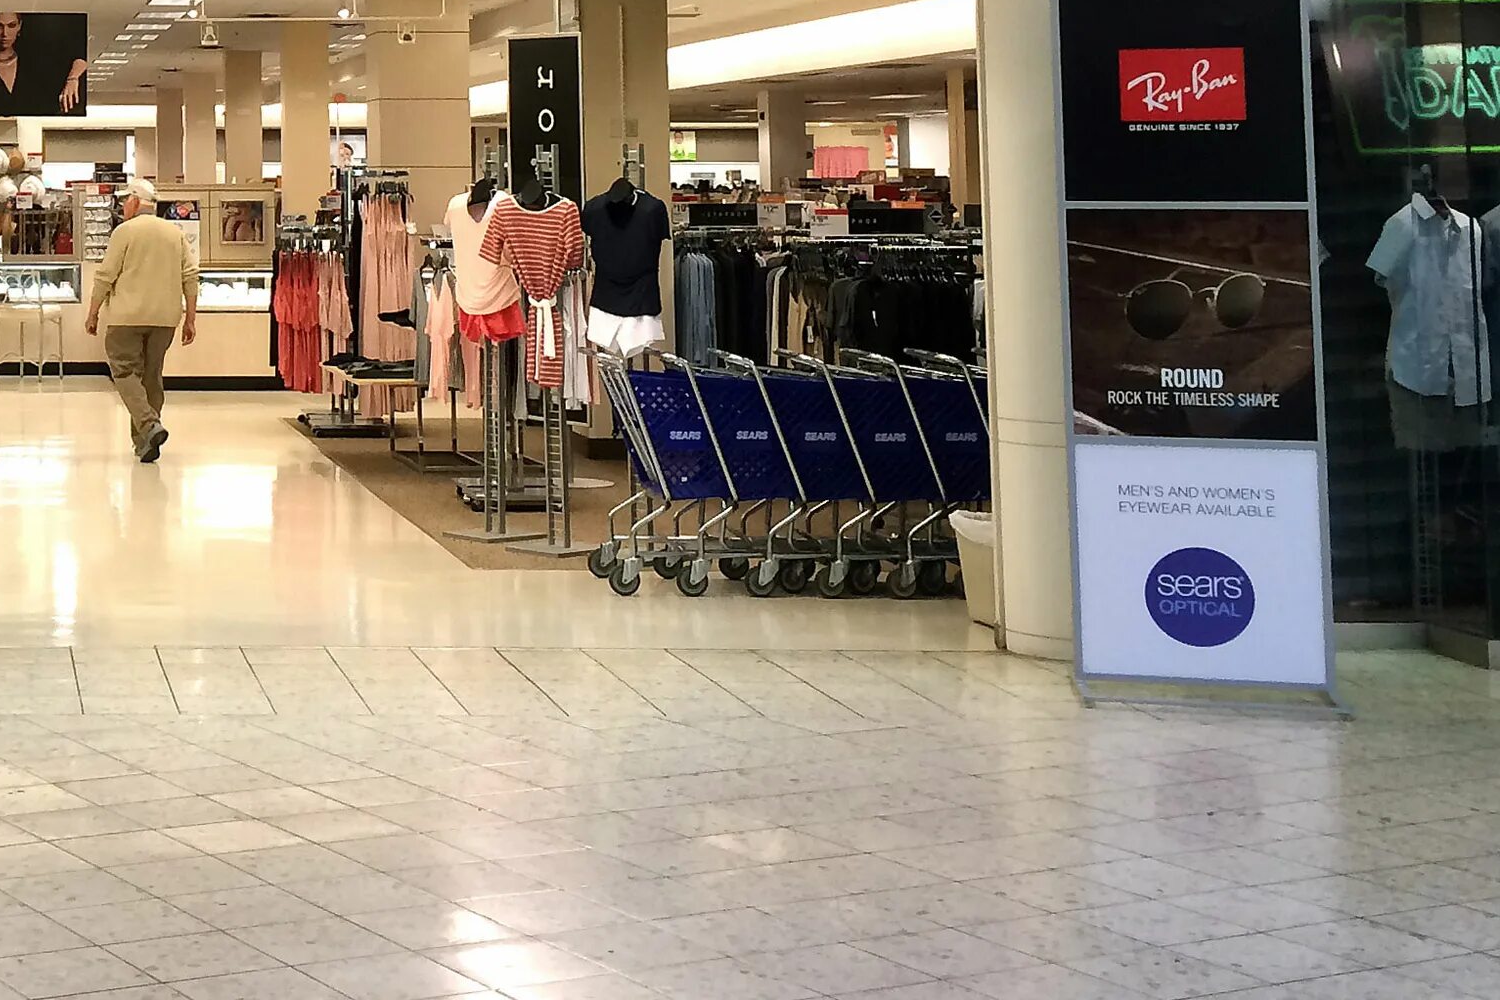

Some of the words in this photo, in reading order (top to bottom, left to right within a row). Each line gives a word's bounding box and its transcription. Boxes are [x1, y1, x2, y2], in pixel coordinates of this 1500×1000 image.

[1127, 59, 1238, 113] Ray-Ban
[1128, 123, 1176, 132] GENUINE
[1179, 123, 1212, 131] SINCE
[1160, 368, 1224, 389] ROUND
[1107, 390, 1143, 405] ROCK
[1145, 391, 1170, 406] THE
[1173, 391, 1235, 408] TIMELESS
[1238, 393, 1280, 408] SHAPE
[669, 430, 702, 440] SEARS
[736, 430, 769, 440] SEARS
[804, 432, 837, 441] SEARS
[874, 432, 907, 442] SEARS
[945, 432, 978, 442] SEARS
[1117, 484, 1165, 498] MEN'S
[1168, 486, 1199, 498] AND
[1202, 487, 1276, 501] WOMEN'S
[1118, 501, 1192, 515] EYEWEAR
[1195, 503, 1277, 518] AVAILABLE
[1157, 574, 1244, 599] sears
[1159, 600, 1242, 617] OPTICAL
